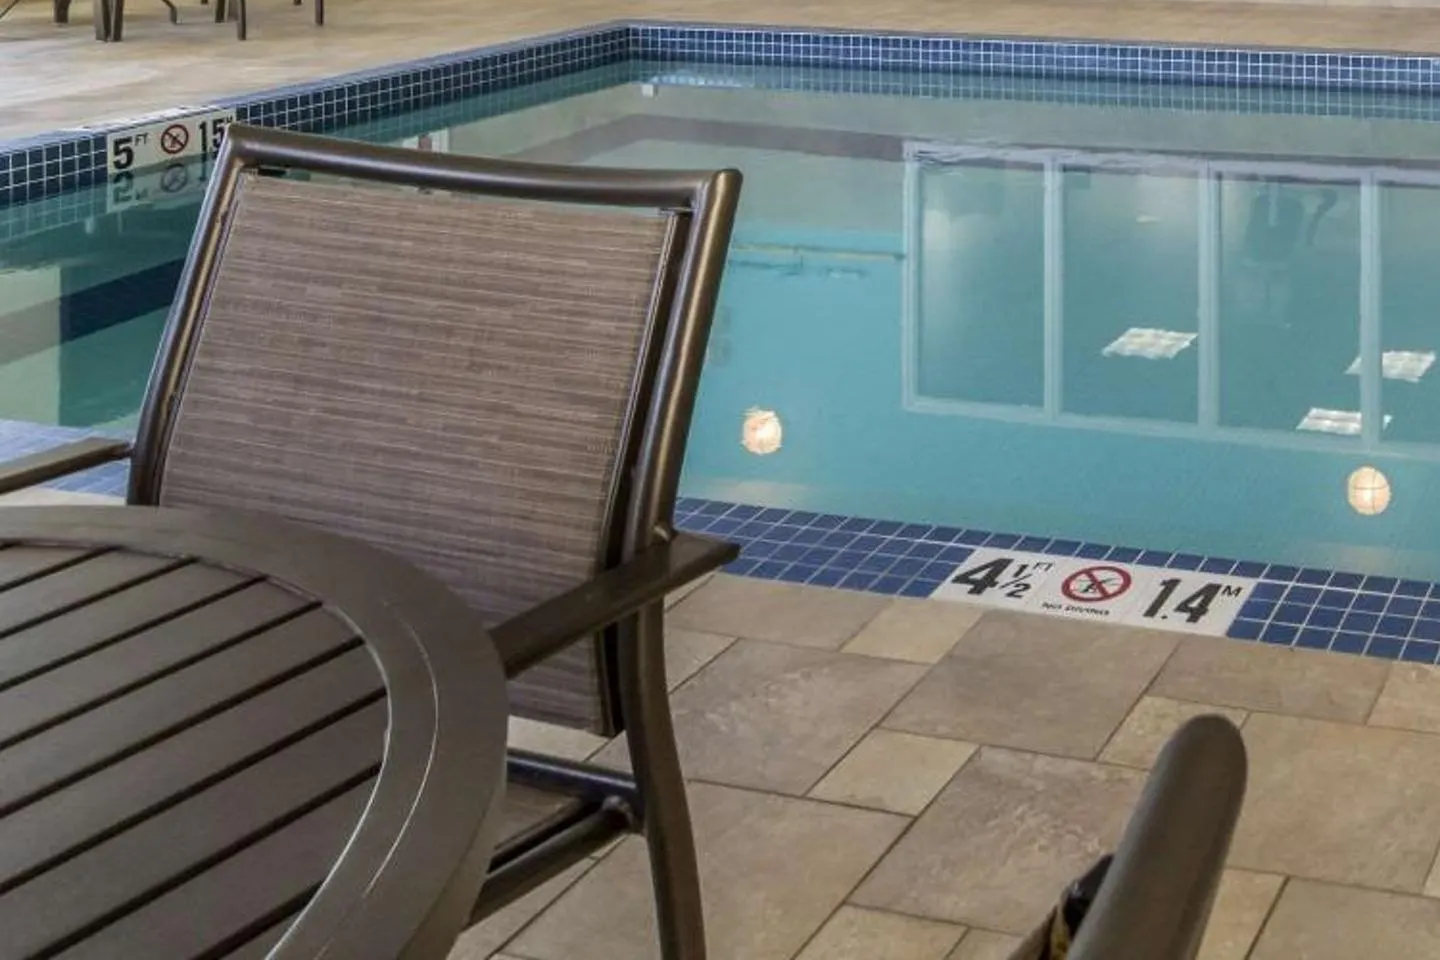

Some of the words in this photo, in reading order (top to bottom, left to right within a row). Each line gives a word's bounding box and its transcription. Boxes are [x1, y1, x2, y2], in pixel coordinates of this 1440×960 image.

[113, 136, 134, 170] 5
[1143, 578, 1222, 623] 1.4
[1222, 585, 1243, 598] M
